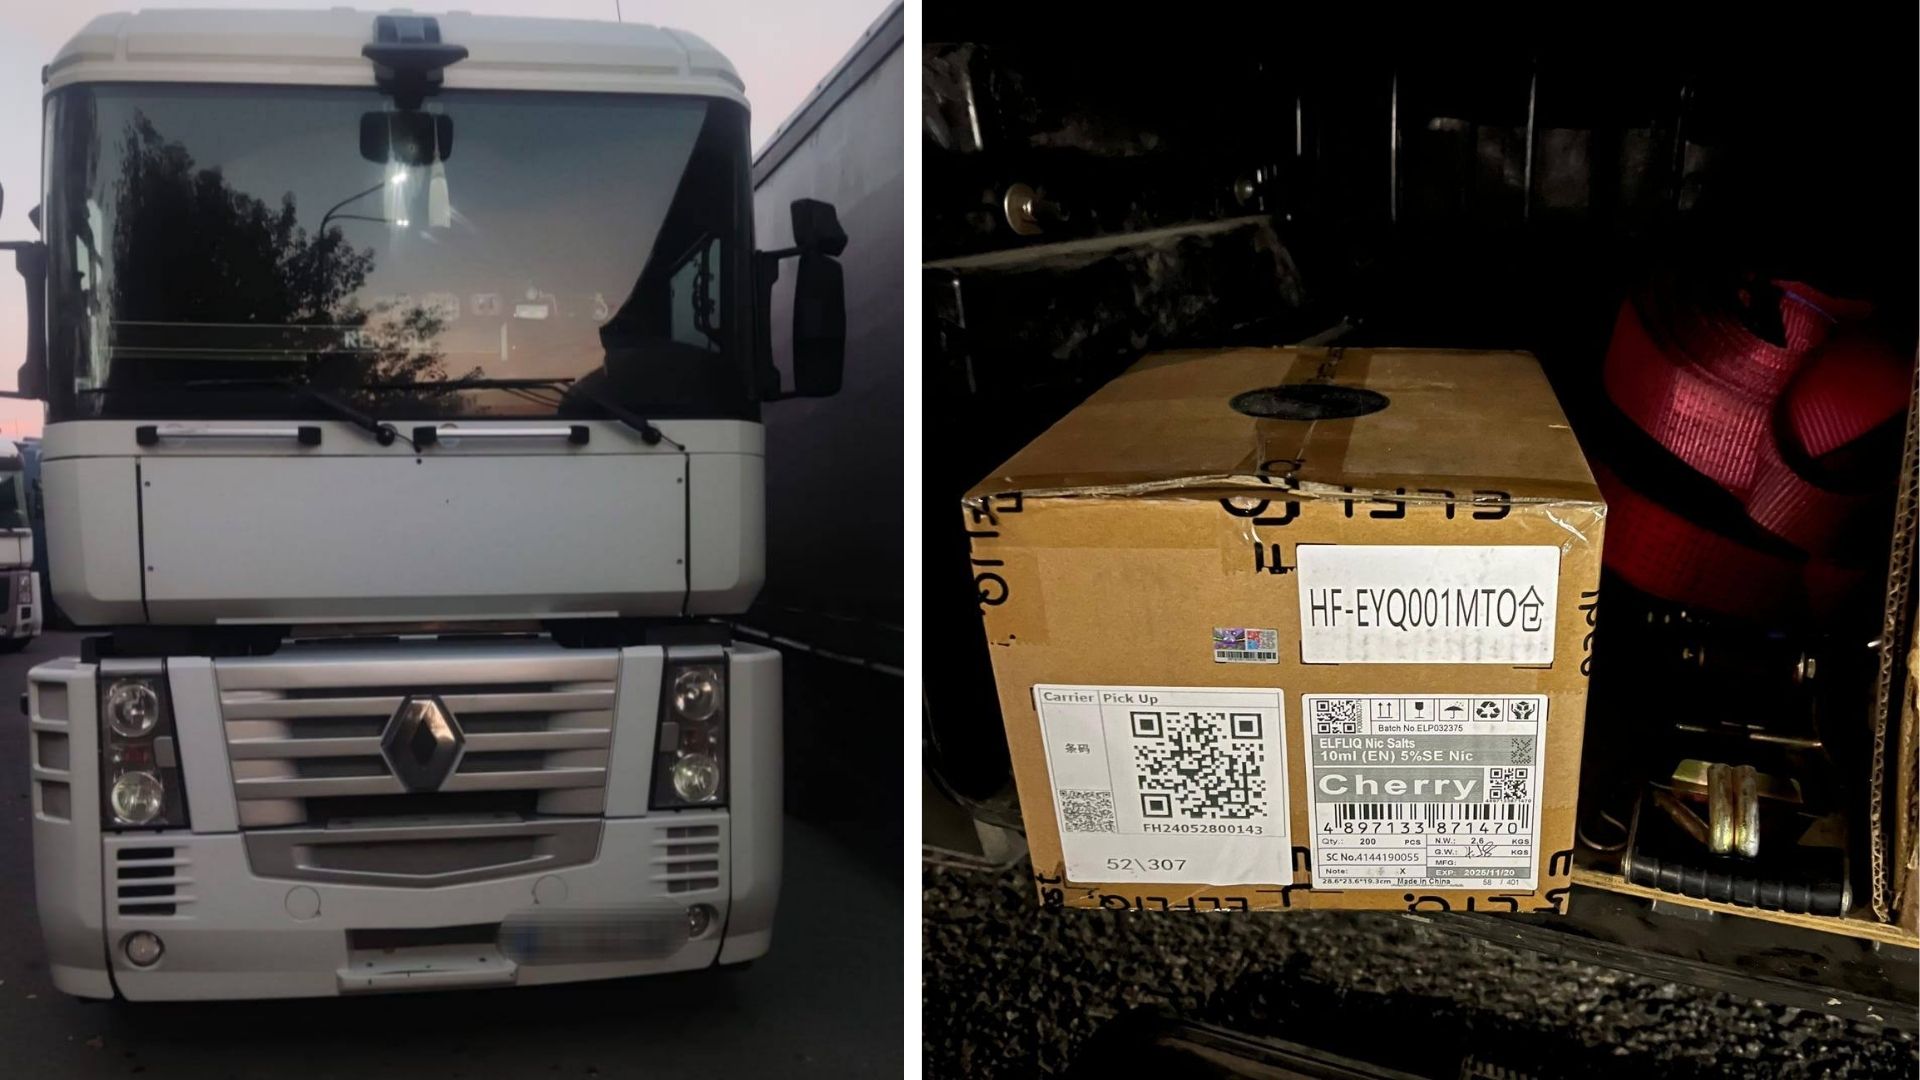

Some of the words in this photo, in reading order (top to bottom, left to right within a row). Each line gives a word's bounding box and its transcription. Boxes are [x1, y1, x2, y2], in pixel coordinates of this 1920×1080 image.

[1309, 585, 1545, 632] HF-EYQ001MTO仓
[1043, 691, 1095, 703] Carrier
[1103, 693, 1134, 704] Pick
[1138, 693, 1159, 706] Up
[1378, 724, 1401, 732] Batch
[1065, 743, 1090, 754] 条码
[1320, 738, 1362, 749] ELFLIQ
[1365, 738, 1384, 748] Nic
[1387, 737, 1415, 749] Salts
[1320, 750, 1357, 761] 10ml
[1362, 750, 1396, 764] (EN)
[1400, 750, 1443, 762] 5%SE
[1449, 750, 1474, 761] Nic
[1318, 773, 1478, 801] Cherry
[1143, 823, 1263, 835] FH24052800143
[1326, 853, 1338, 862] SC
[1463, 869, 1515, 877] 2025/11/20
